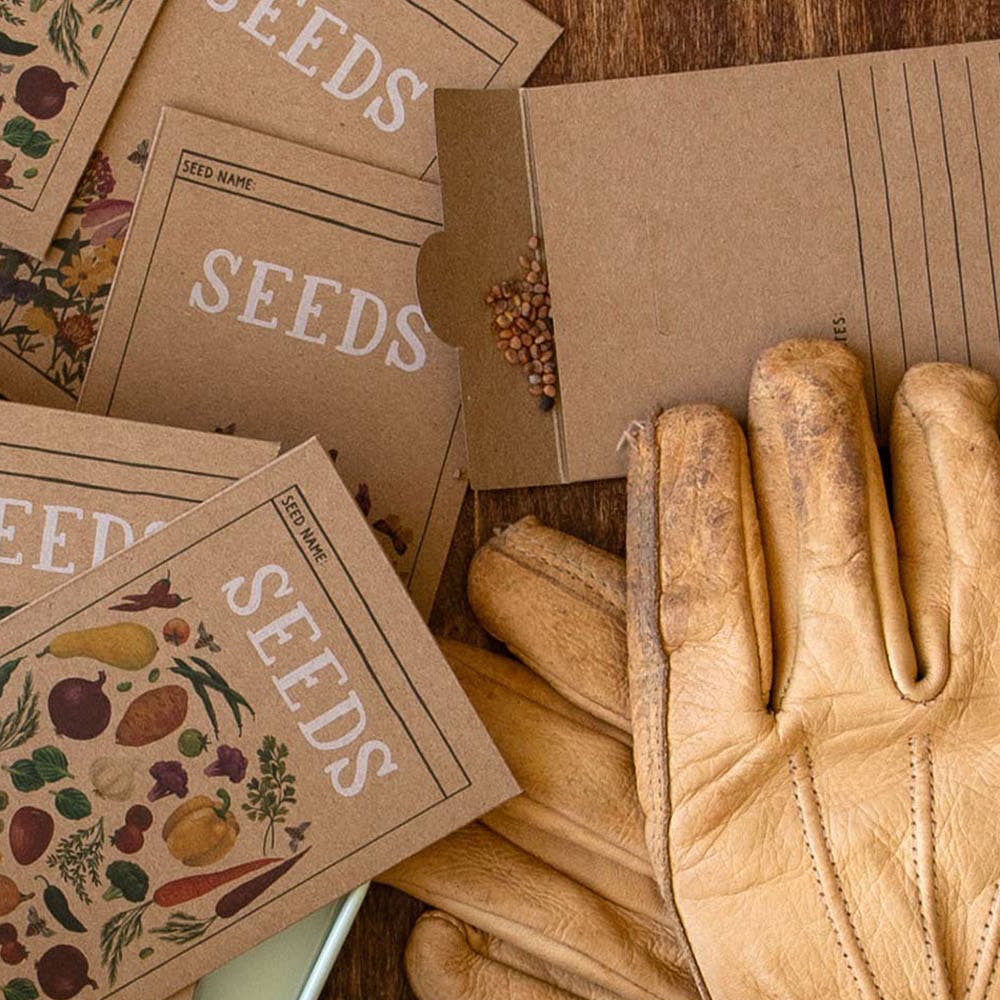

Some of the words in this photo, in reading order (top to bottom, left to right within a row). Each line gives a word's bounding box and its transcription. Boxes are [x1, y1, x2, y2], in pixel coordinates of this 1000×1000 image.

[206, 0, 428, 132] EEDS
[182, 160, 213, 179] SEED
[217, 173, 256, 191] NAME:
[189, 248, 431, 372] SEEDS
[832, 311, 848, 342] TES:
[281, 495, 305, 527] SEED
[299, 528, 328, 565] NAME:
[220, 564, 398, 797] SEEDS
